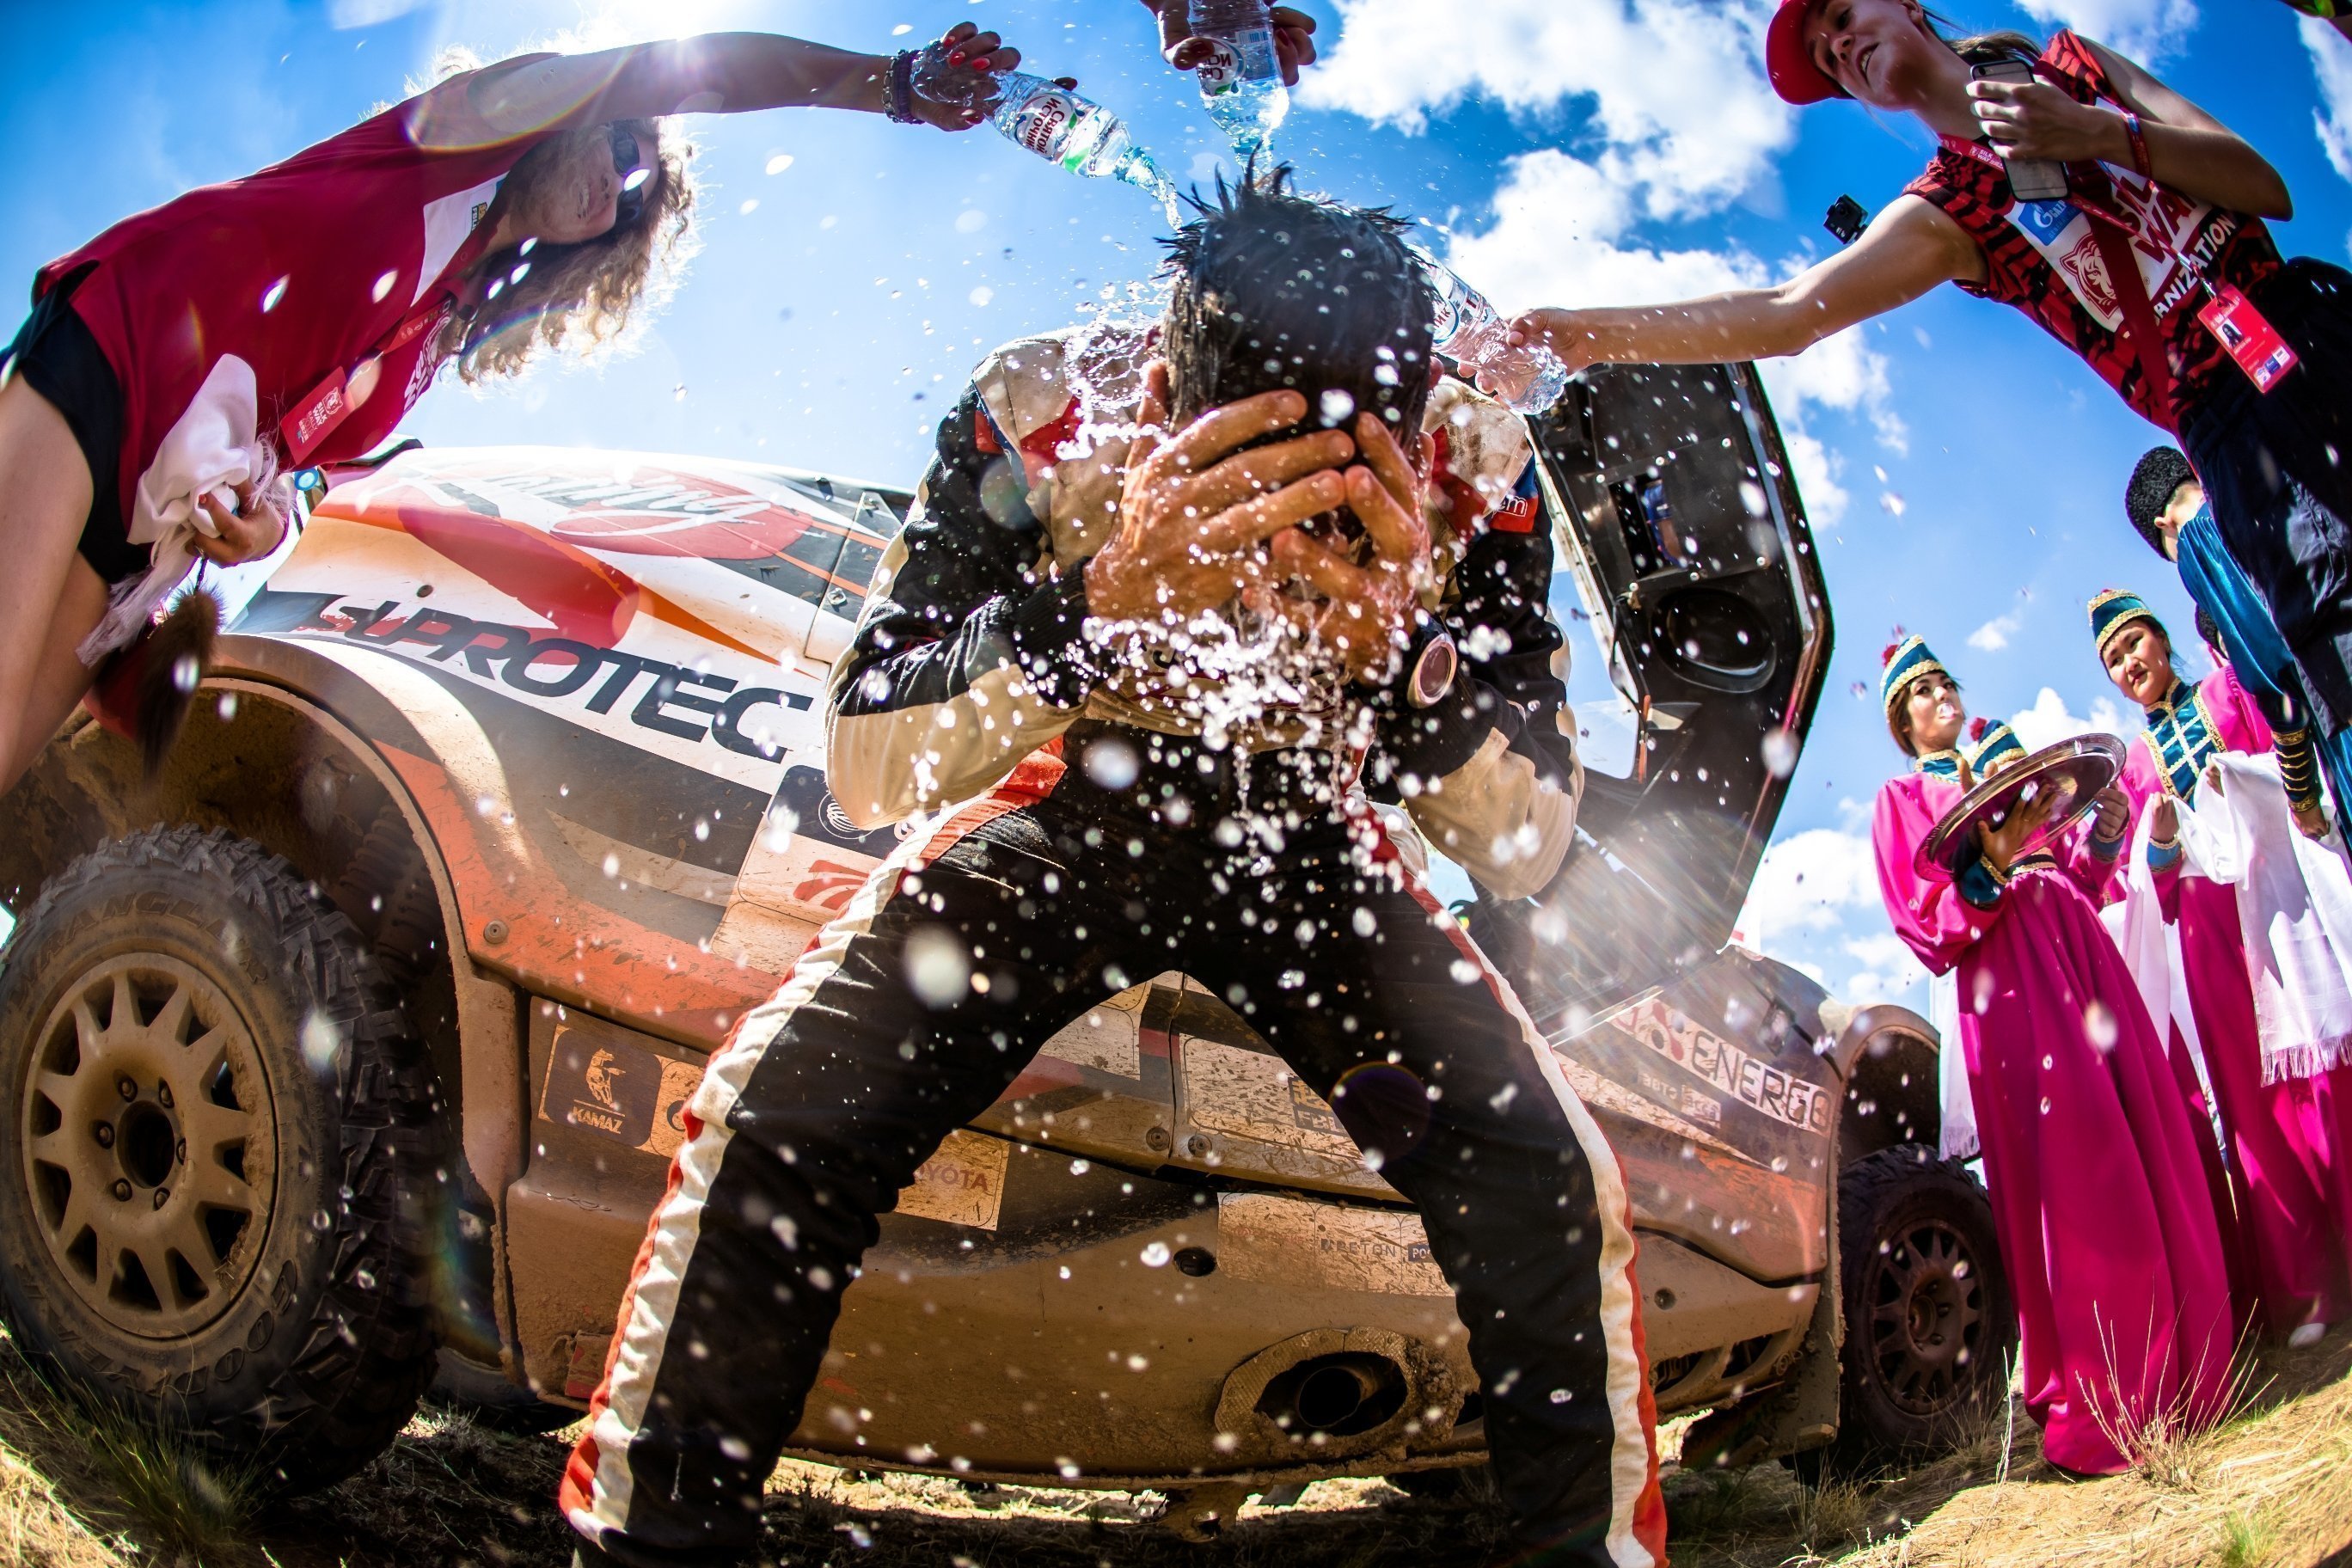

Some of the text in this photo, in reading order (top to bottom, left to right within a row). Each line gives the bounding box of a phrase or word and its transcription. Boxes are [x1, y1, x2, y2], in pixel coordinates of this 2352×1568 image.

[2153, 213, 2237, 327] ANIZATION
[312, 406, 323, 426] WAY
[316, 401, 328, 420] SILK
[291, 596, 813, 764] SUPROTEC
[1691, 1030, 1832, 1132] ENERGO
[571, 1106, 623, 1135] KAMAZ
[919, 1164, 989, 1192] YOTA
